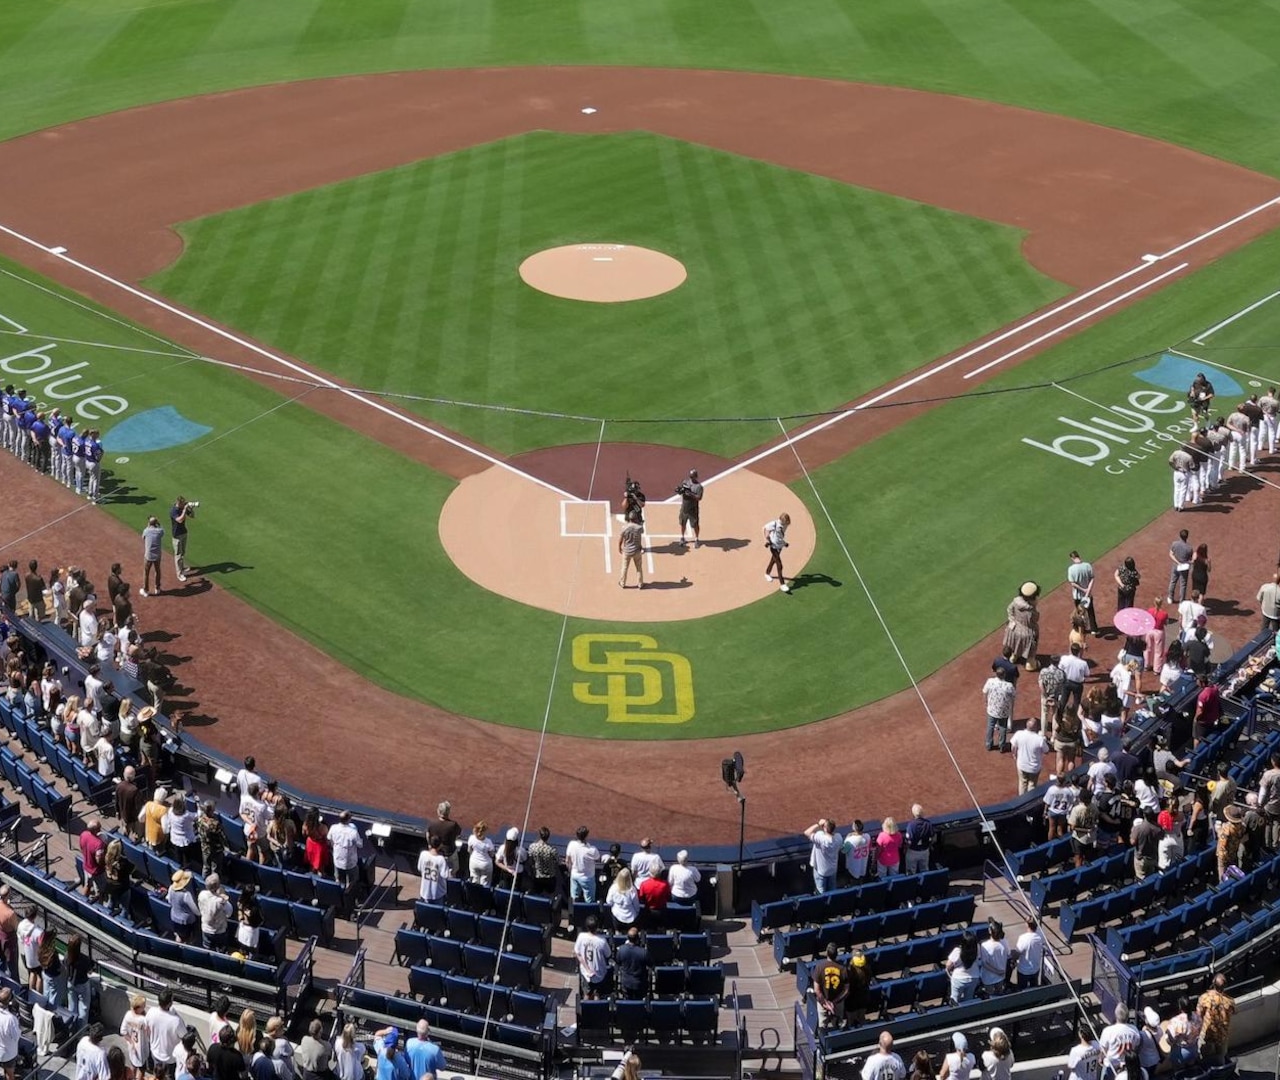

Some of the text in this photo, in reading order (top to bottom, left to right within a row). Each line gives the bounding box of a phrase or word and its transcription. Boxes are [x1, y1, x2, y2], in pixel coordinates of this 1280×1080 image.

[1021, 390, 1186, 467] blue
[571, 633, 696, 724] SD
[1054, 800, 1068, 810] 23
[853, 847, 869, 860] 23
[424, 867, 438, 882] 23
[824, 976, 841, 990] 19
[1086, 1059, 1097, 1074] 13
